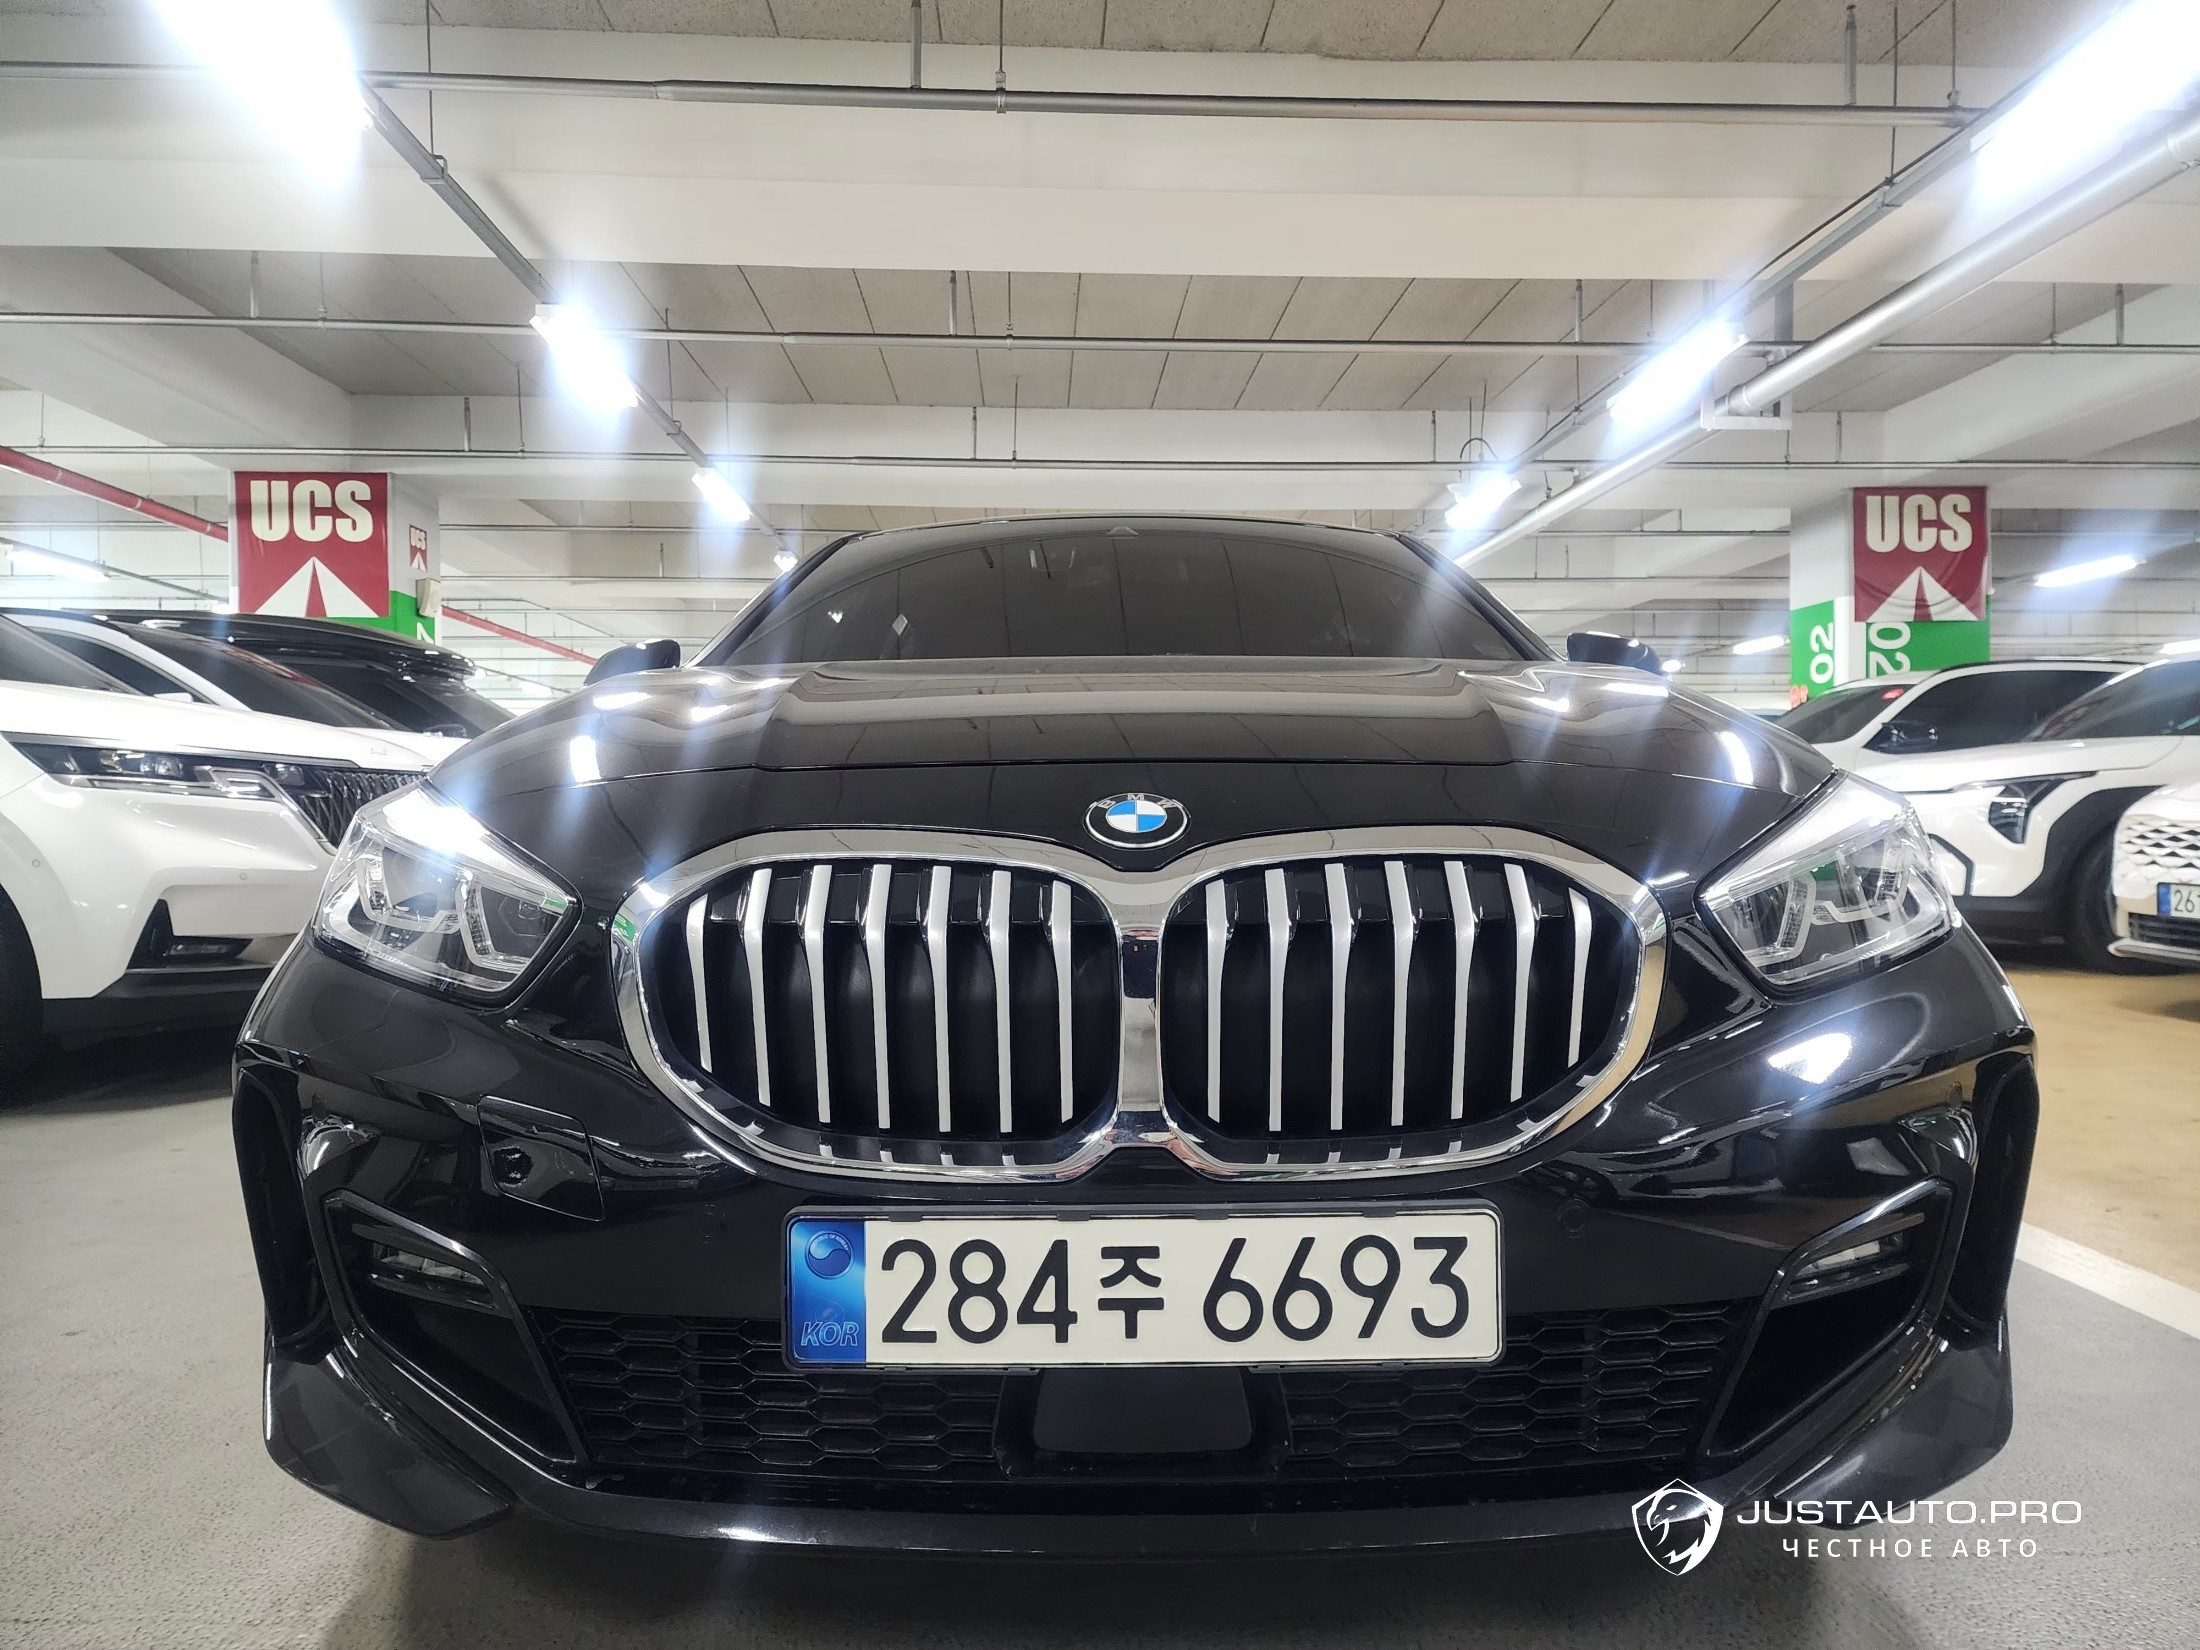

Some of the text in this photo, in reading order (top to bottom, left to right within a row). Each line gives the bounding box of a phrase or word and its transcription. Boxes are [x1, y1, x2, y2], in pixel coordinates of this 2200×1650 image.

[250, 479, 373, 542] UCS
[410, 527, 426, 550] UCS
[1866, 493, 1972, 553] UCS
[1809, 622, 1833, 684] 02
[1869, 622, 1911, 678] 02
[1098, 792, 1178, 809] BMW
[2174, 889, 2200, 913] 26
[881, 1234, 1469, 1344] 284주 6693
[800, 1321, 859, 1346] KOR
